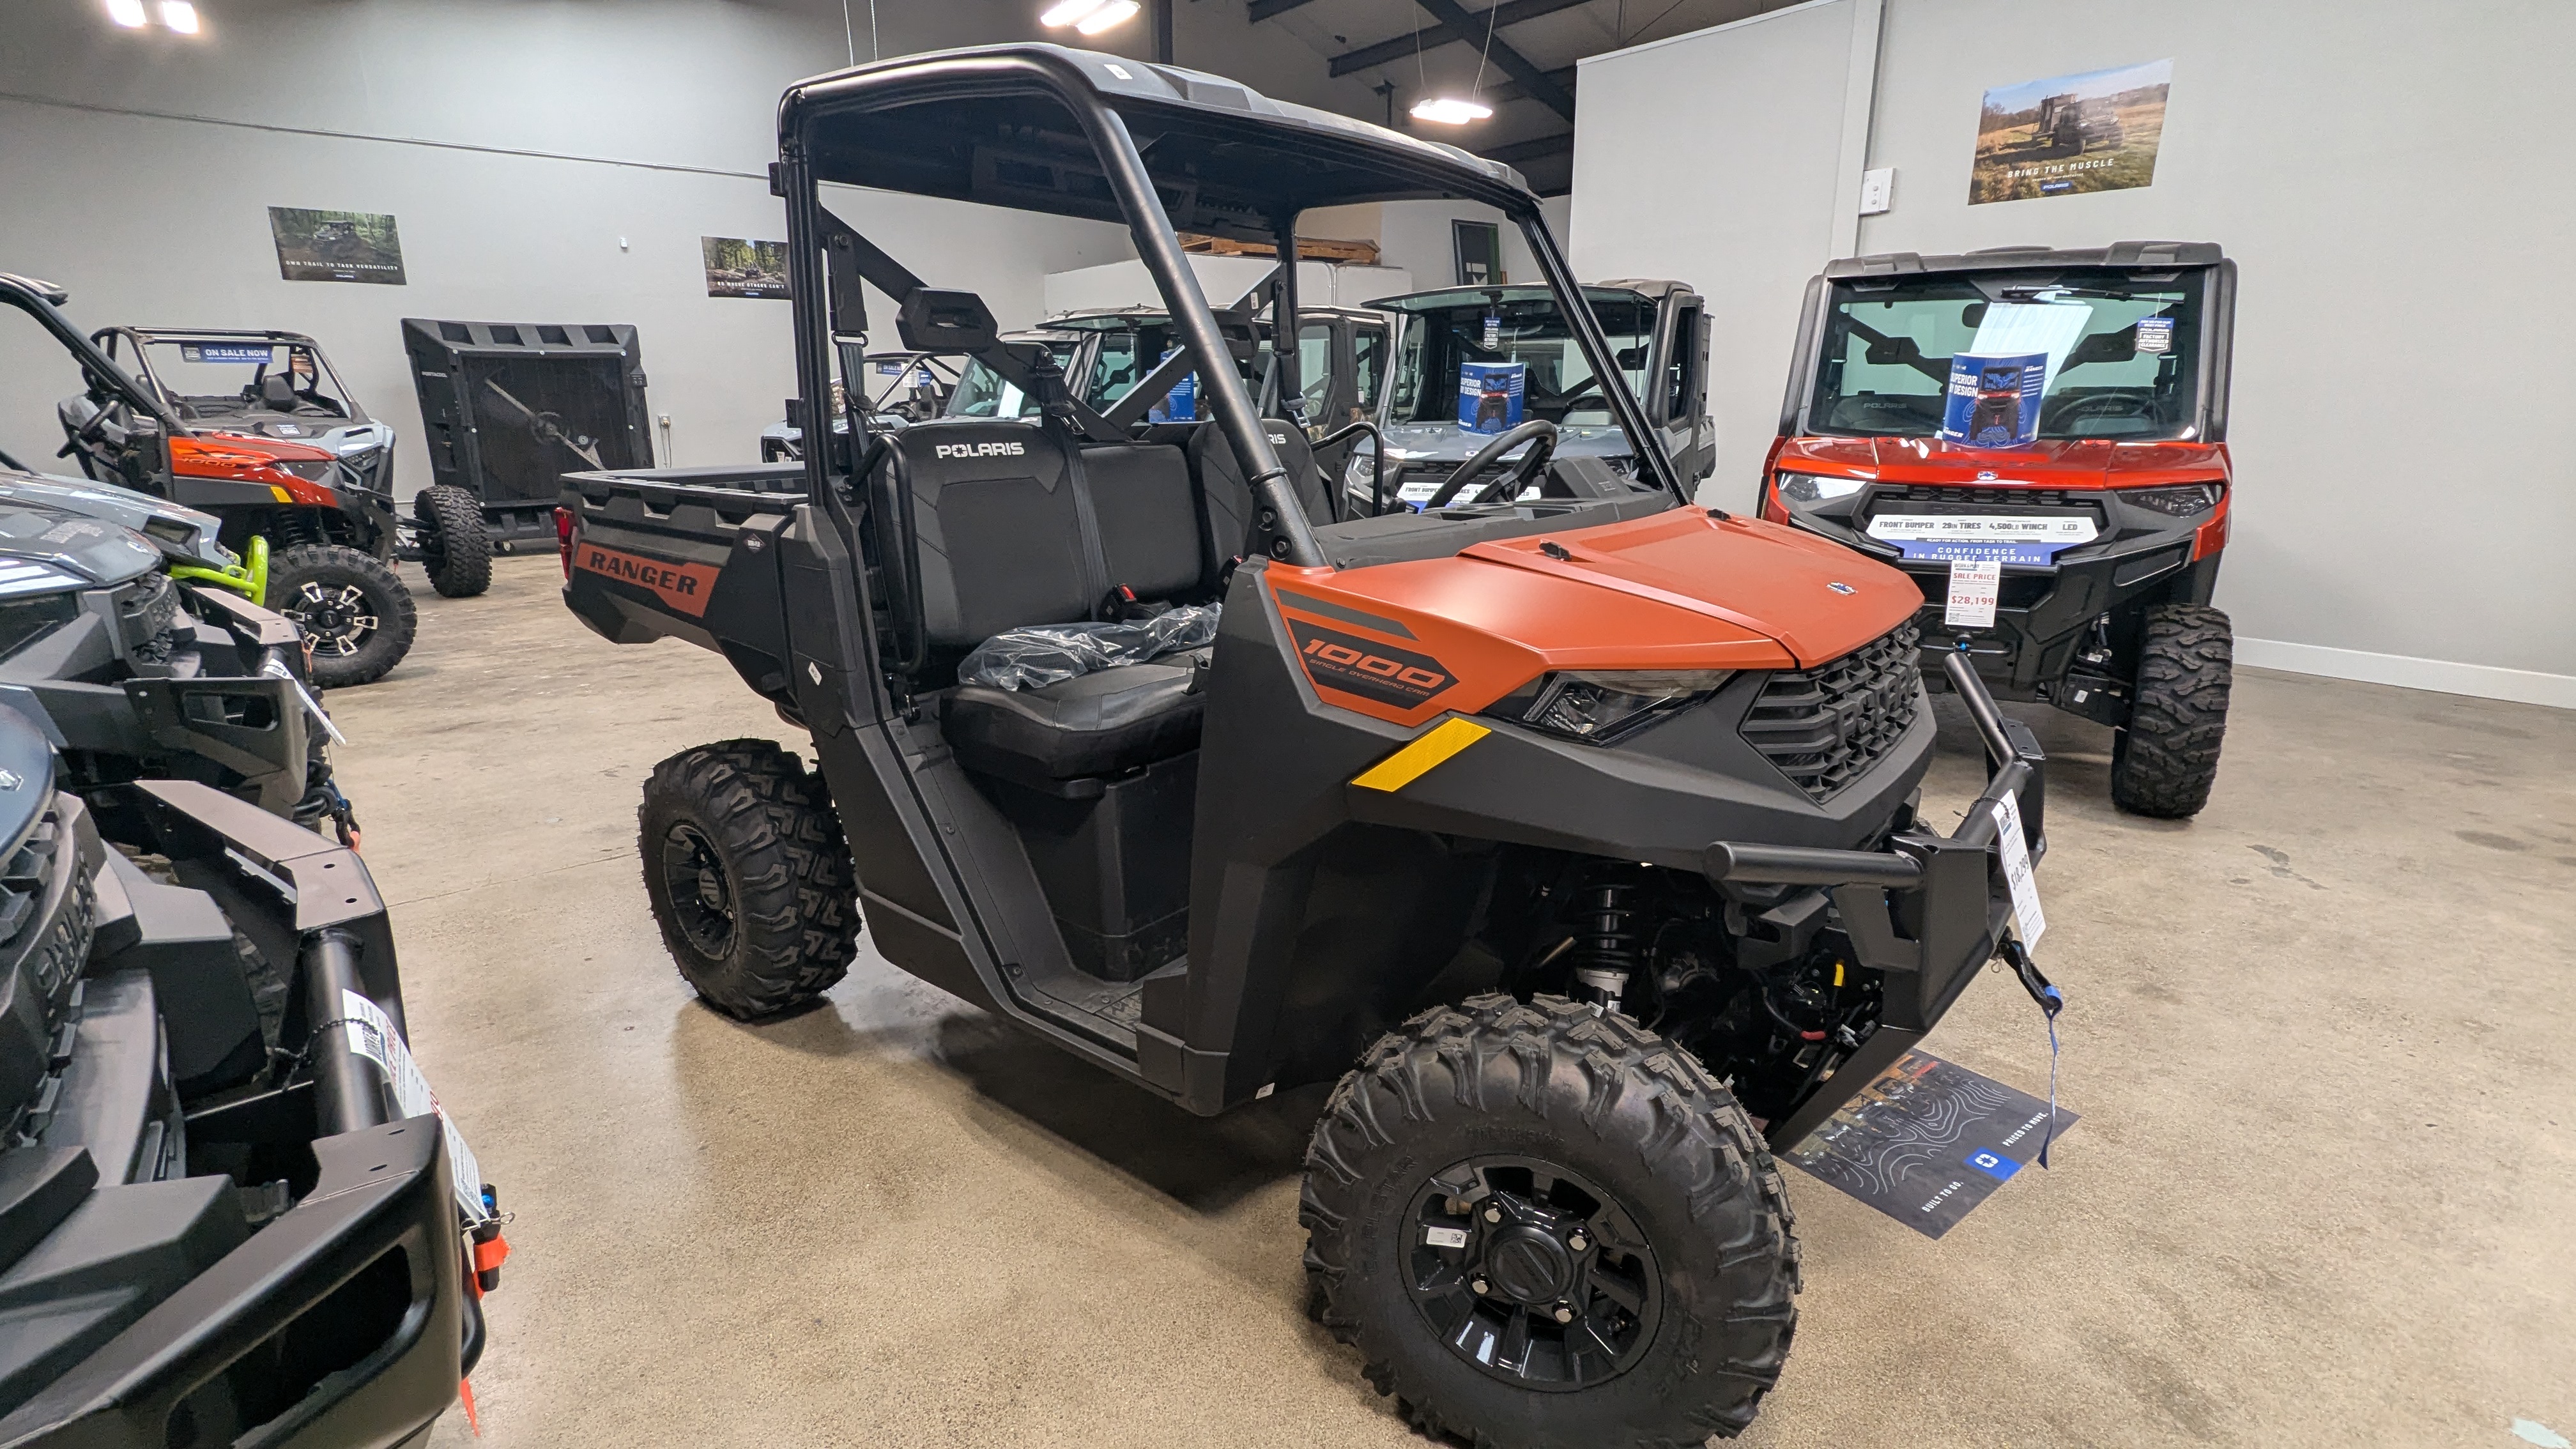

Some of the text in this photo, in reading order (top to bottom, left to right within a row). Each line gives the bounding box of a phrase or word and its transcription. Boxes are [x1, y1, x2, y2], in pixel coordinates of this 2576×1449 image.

[2007, 158, 2115, 178] BRING THE MUSCLE
[1464, 387, 1482, 397] DESIGN
[1954, 385, 1979, 397] DESIGN
[935, 442, 1025, 459] POLARIS
[590, 551, 698, 595] RANGER
[1951, 595, 1995, 606] $28,199
[1303, 639, 1445, 689] 1000
[1309, 659, 1430, 697] SINGLE OVERHEAD CAM
[2011, 854, 2030, 891] $18,299
[2002, 1112, 2049, 1147] PRICED TO MOVE.
[1922, 1181, 1964, 1213] BUILT TO GO.
